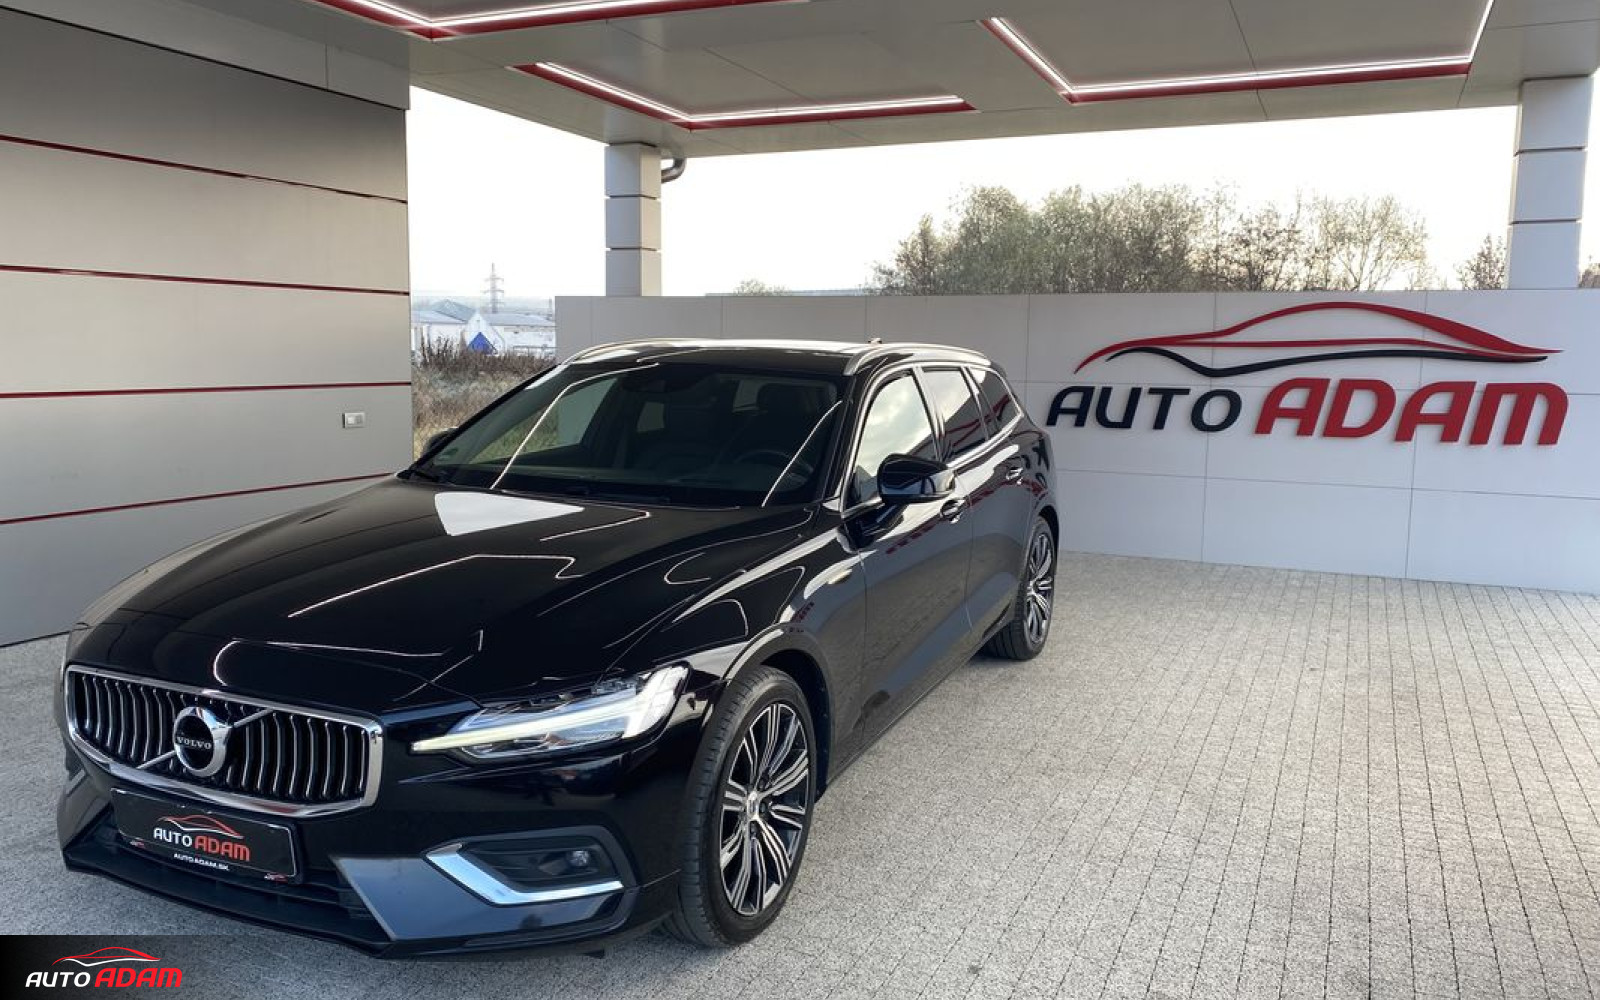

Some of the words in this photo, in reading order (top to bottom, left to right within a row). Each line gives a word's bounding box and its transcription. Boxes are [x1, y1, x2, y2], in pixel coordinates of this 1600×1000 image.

[1046, 385, 1243, 432] AUTO
[1254, 377, 1569, 446] ADAM
[176, 736, 212, 750] VOLVO
[153, 827, 193, 848] AUTO
[194, 835, 250, 862] ADAM
